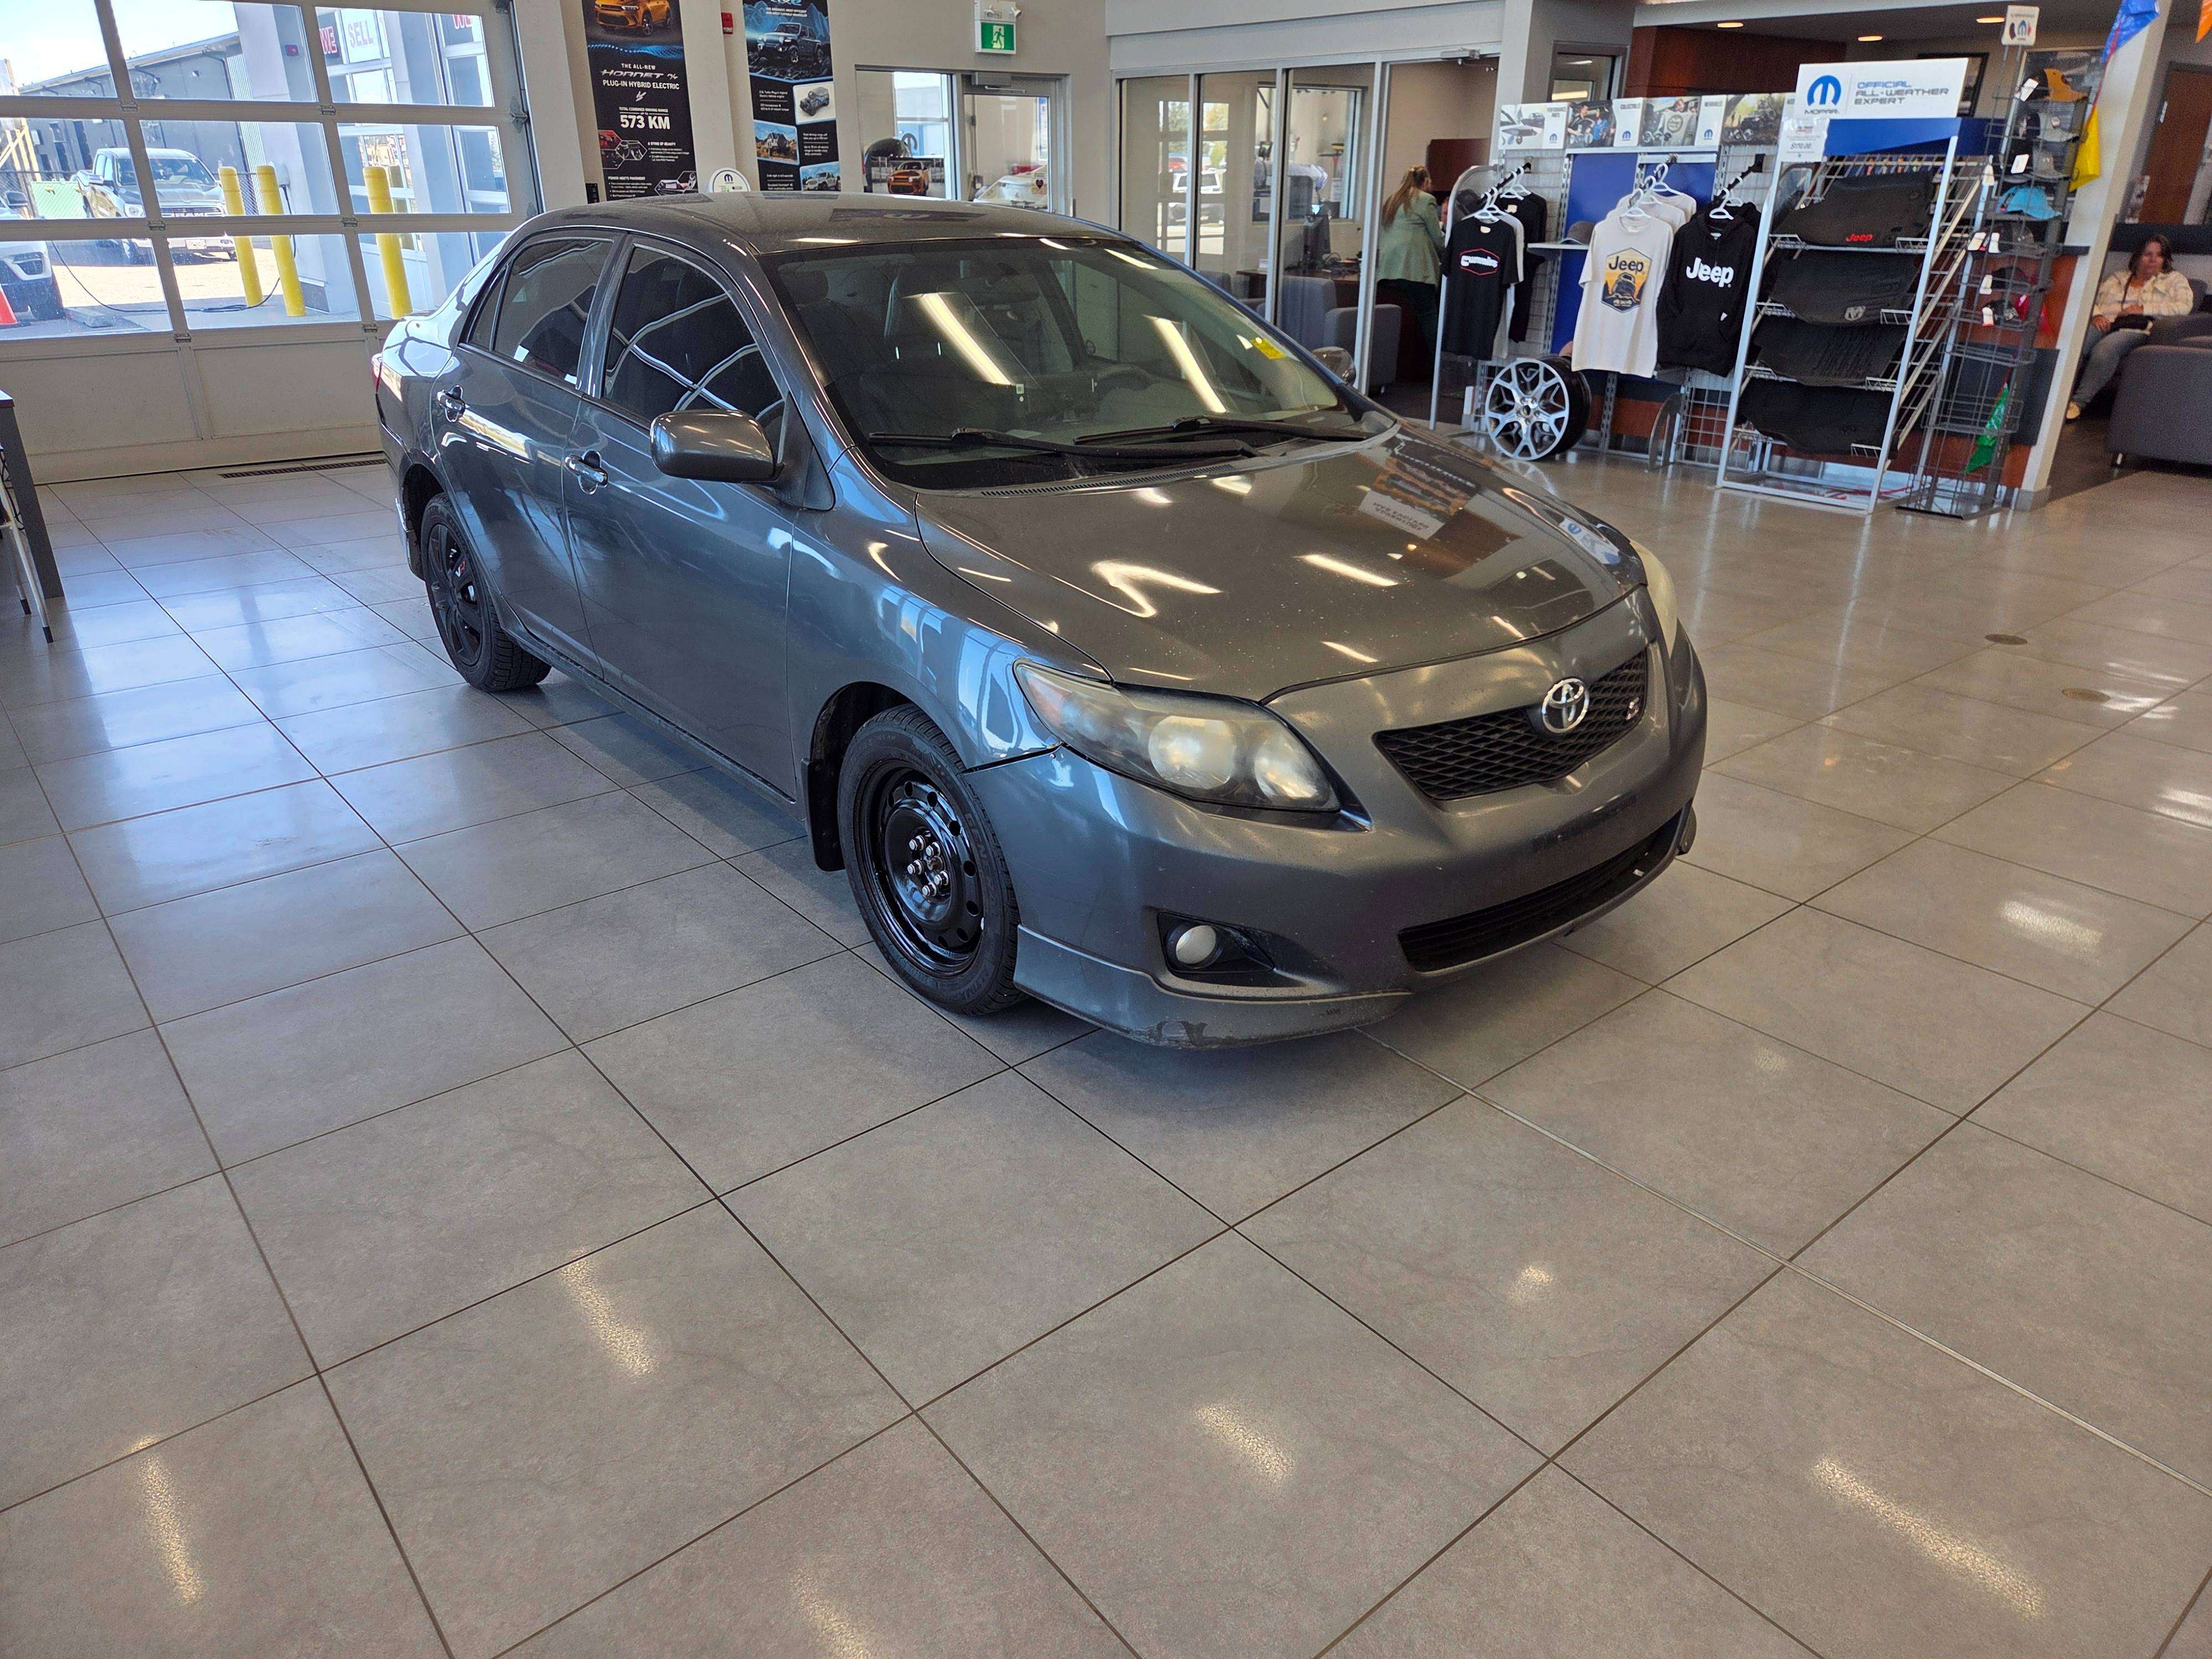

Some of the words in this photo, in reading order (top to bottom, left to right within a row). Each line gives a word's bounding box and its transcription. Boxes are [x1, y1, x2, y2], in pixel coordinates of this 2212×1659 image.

[319, 27, 337, 54] WE
[348, 20, 374, 48] SELL
[1856, 81, 1912, 89] OFFICIAL
[1854, 97, 1906, 105] EXPERT
[620, 114, 645, 128] 573
[648, 116, 670, 129] KM
[1845, 233, 1874, 242] Jeep
[1609, 256, 1644, 274] Jeep
[1686, 257, 1734, 288] Jeep
